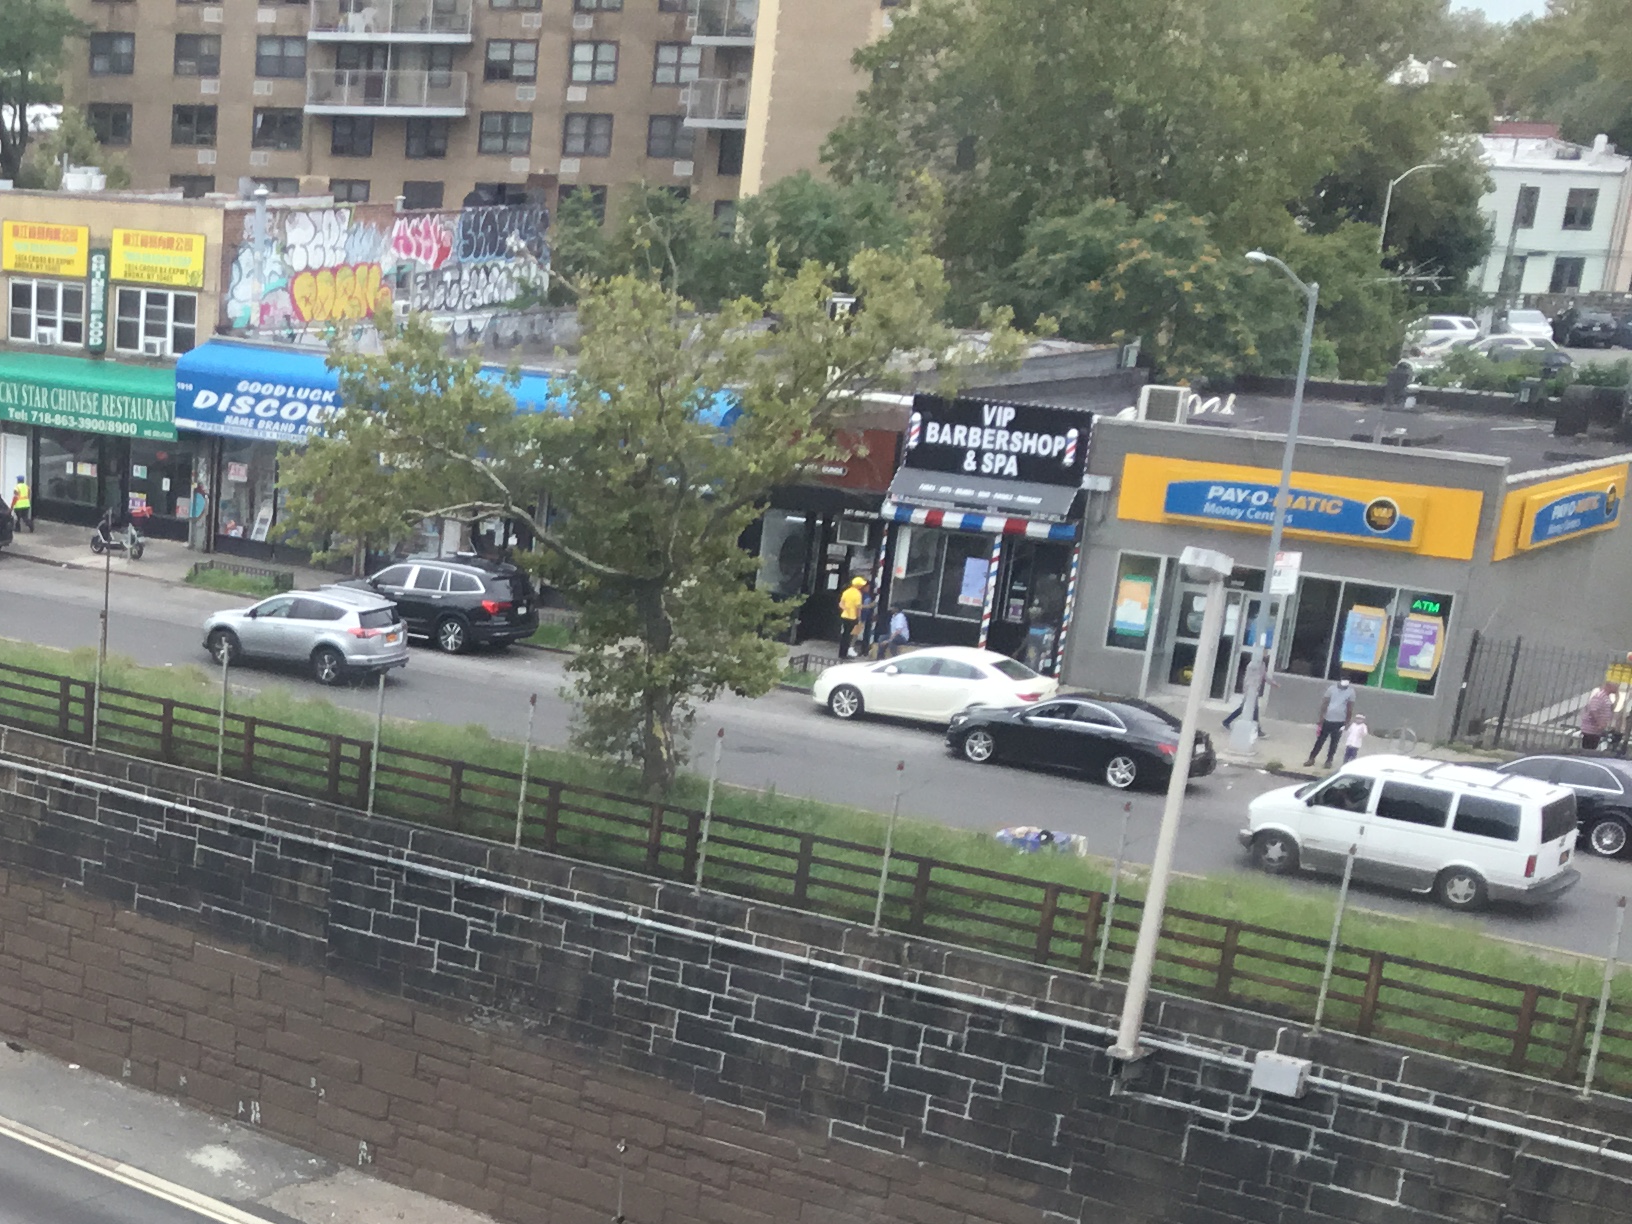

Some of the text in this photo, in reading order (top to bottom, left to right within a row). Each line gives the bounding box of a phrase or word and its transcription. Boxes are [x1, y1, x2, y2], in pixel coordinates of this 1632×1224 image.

[89, 254, 106, 346] CHINESE FOOD
[21, 384, 48, 409] STAR
[50, 388, 99, 416] CHINESE
[101, 394, 177, 424] RESTAURANT
[982, 404, 1017, 428] VIP
[31, 410, 138, 435] 718-863-3900/8900
[224, 415, 256, 429] NAME
[257, 419, 296, 434] BRAND
[925, 421, 1067, 457] BARBERSHOP
[963, 450, 1019, 477] & SPA
[1202, 501, 1244, 518] Money
[1412, 600, 1440, 613] ATM
